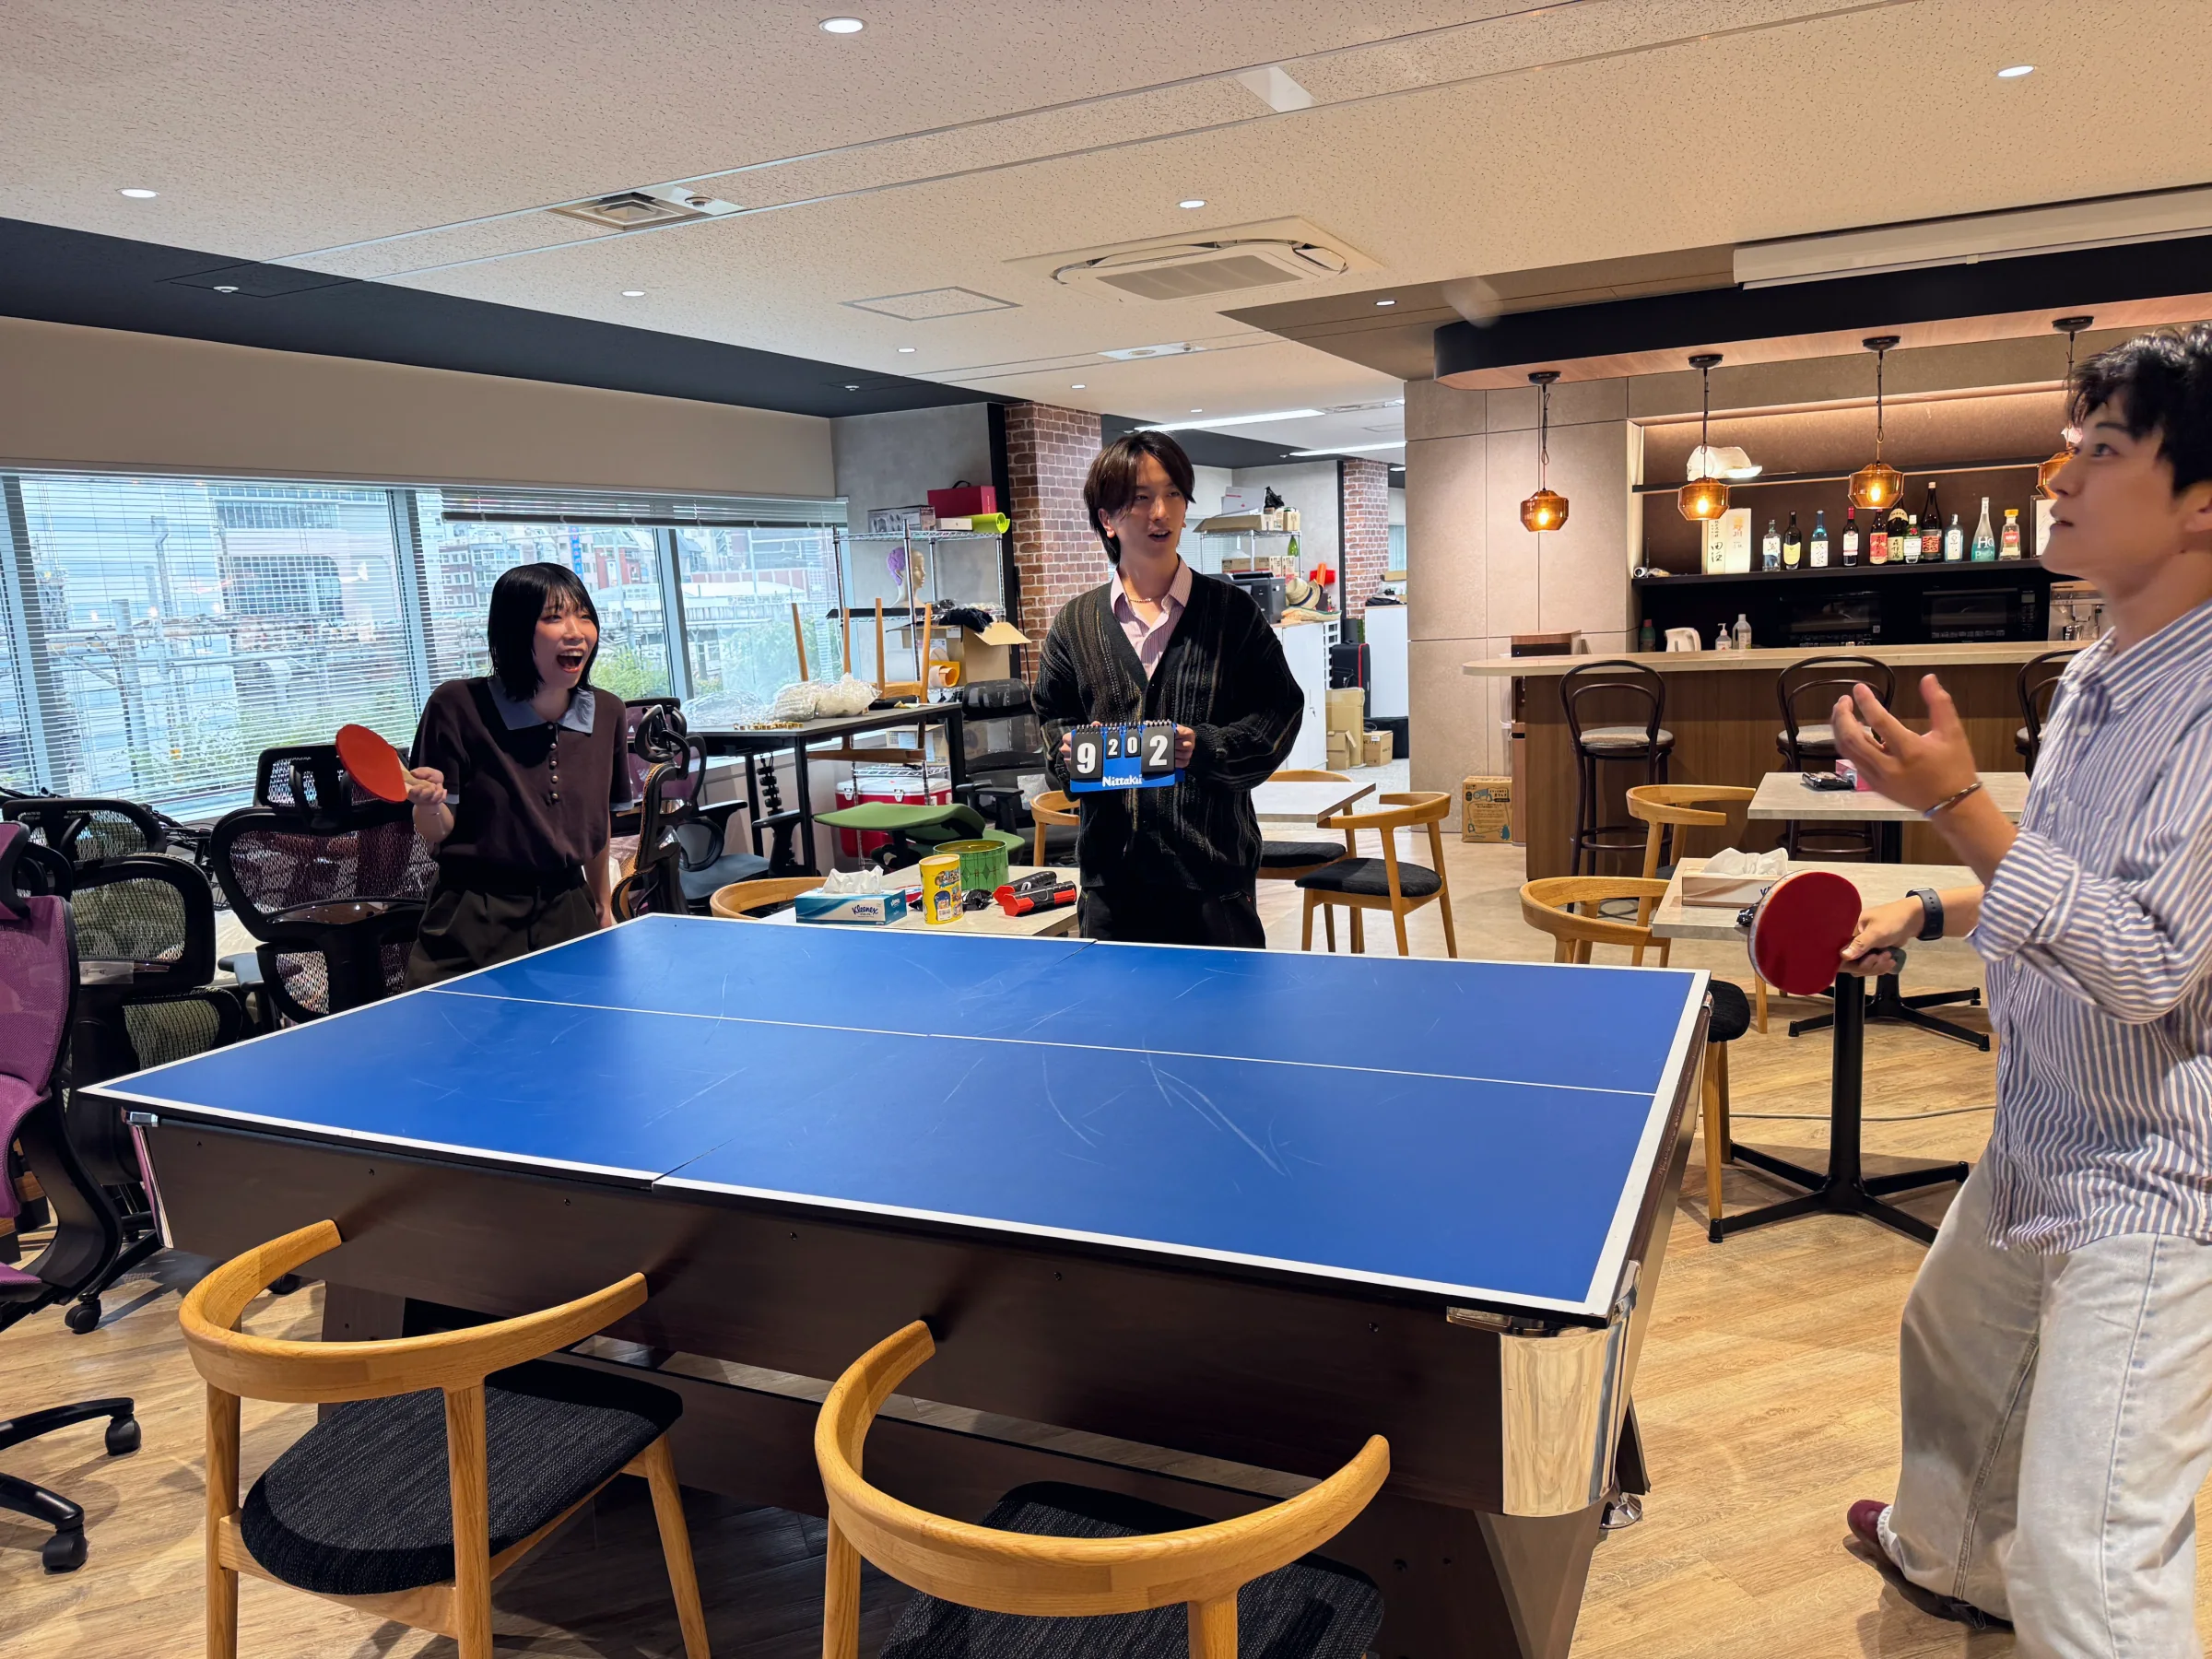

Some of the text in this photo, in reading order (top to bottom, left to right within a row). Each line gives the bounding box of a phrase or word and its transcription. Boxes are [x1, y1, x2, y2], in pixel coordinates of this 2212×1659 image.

[1077, 735, 1168, 774] 9 2 0 2
[1102, 775, 1143, 787] Nittaku
[851, 904, 879, 915] Kleenex
